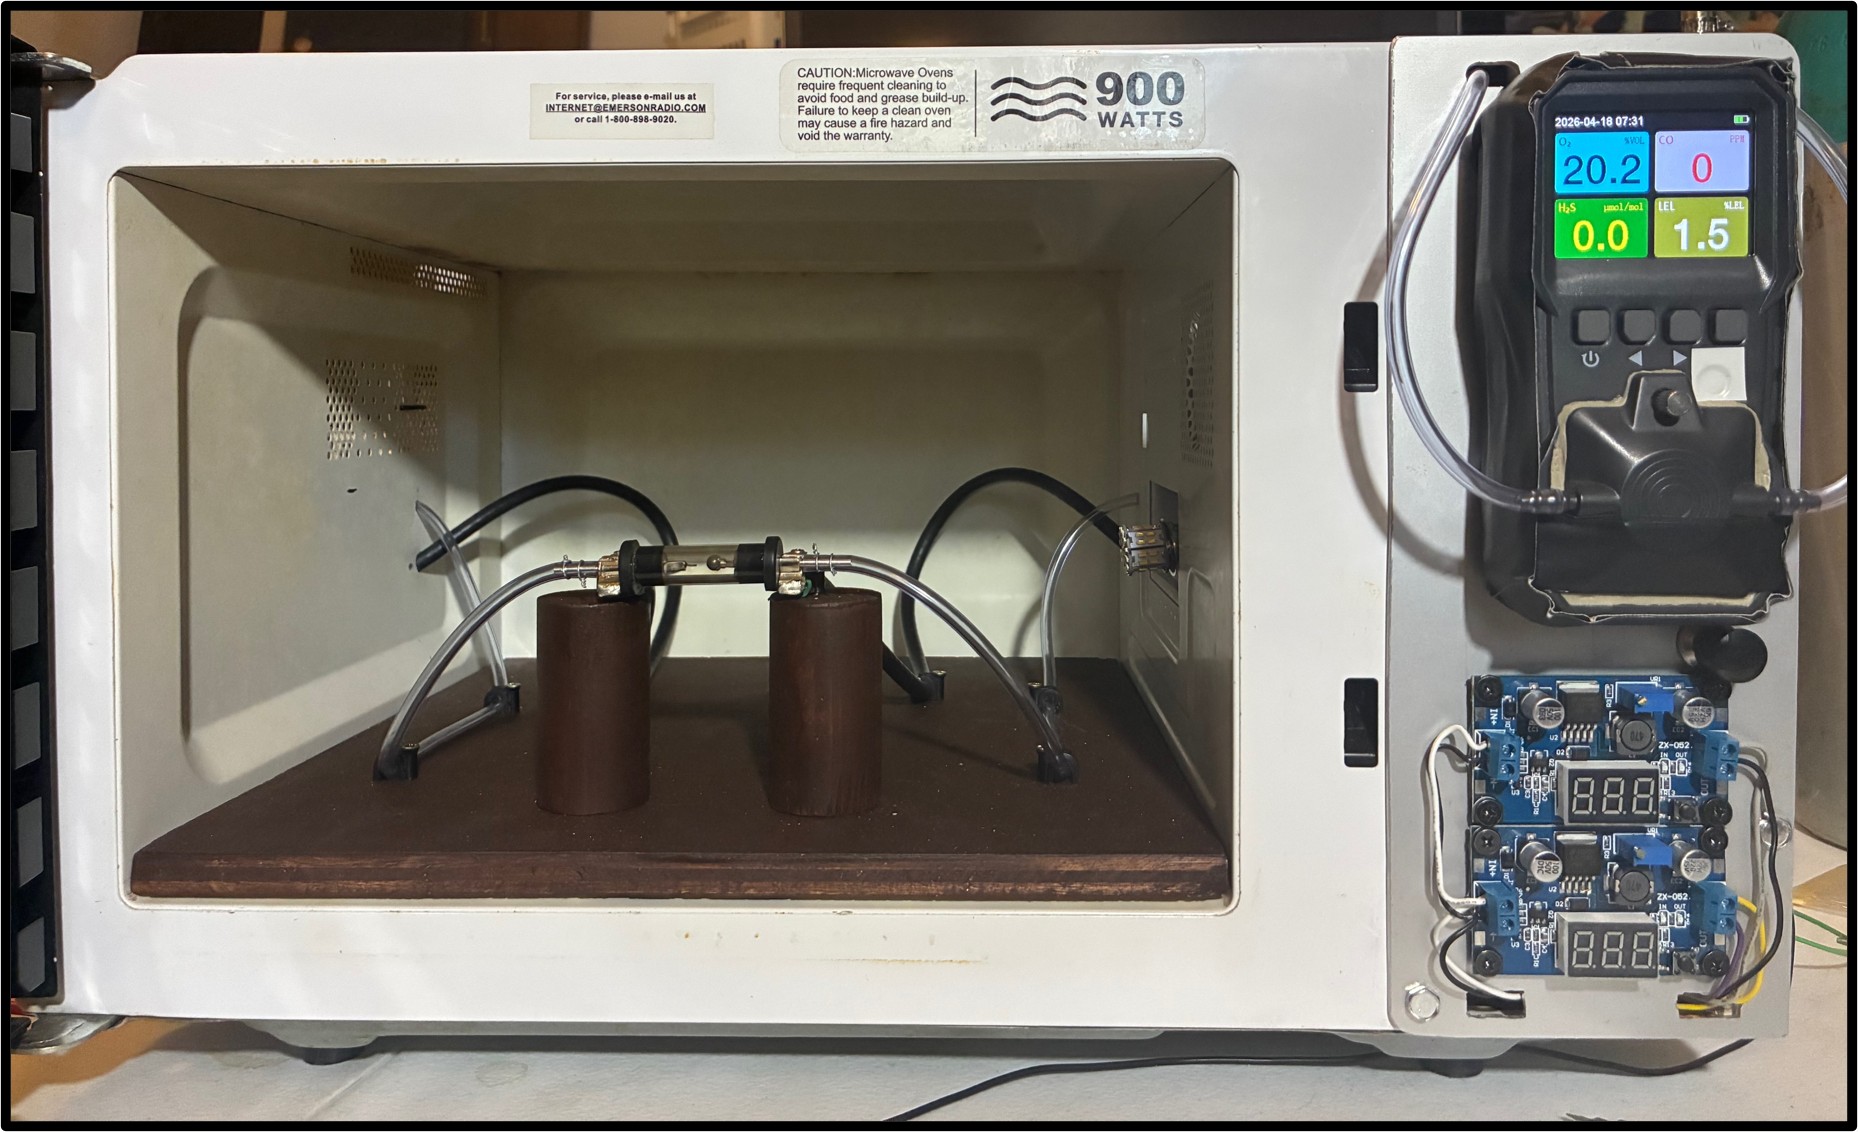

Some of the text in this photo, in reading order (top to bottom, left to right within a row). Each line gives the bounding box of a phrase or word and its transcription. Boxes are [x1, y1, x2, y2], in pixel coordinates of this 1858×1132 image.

[917, 67, 954, 78] Ovens
[797, 80, 947, 92] require frequent cleaning to
[1095, 71, 1185, 106] 900
[555, 92, 571, 100] For
[572, 92, 609, 101] service,
[611, 92, 642, 101] please
[643, 92, 672, 100] e-mail
[797, 93, 969, 105] avoid food and grease build-up.
[545, 103, 707, 112] INTERNET@EMERSONRADIO.COM
[797, 105, 951, 118] Failure to keep a clean oven
[586, 115, 603, 123] call
[605, 115, 677, 123] 1-800-898-9020.
[797, 118, 952, 130] may cause a fire hazard and
[1097, 111, 1184, 128] WATTS
[1555, 116, 1644, 128] 2026-04-18 07:31
[797, 130, 893, 143] void the warranty.
[1624, 136, 1645, 145] %VOL
[1659, 135, 1674, 145] CO
[1563, 154, 1641, 185] 20.2
[1692, 153, 1713, 184] 0
[1658, 201, 1675, 211] LEL
[1573, 219, 1629, 252] 0.0
[1673, 218, 1730, 251] 1.5
